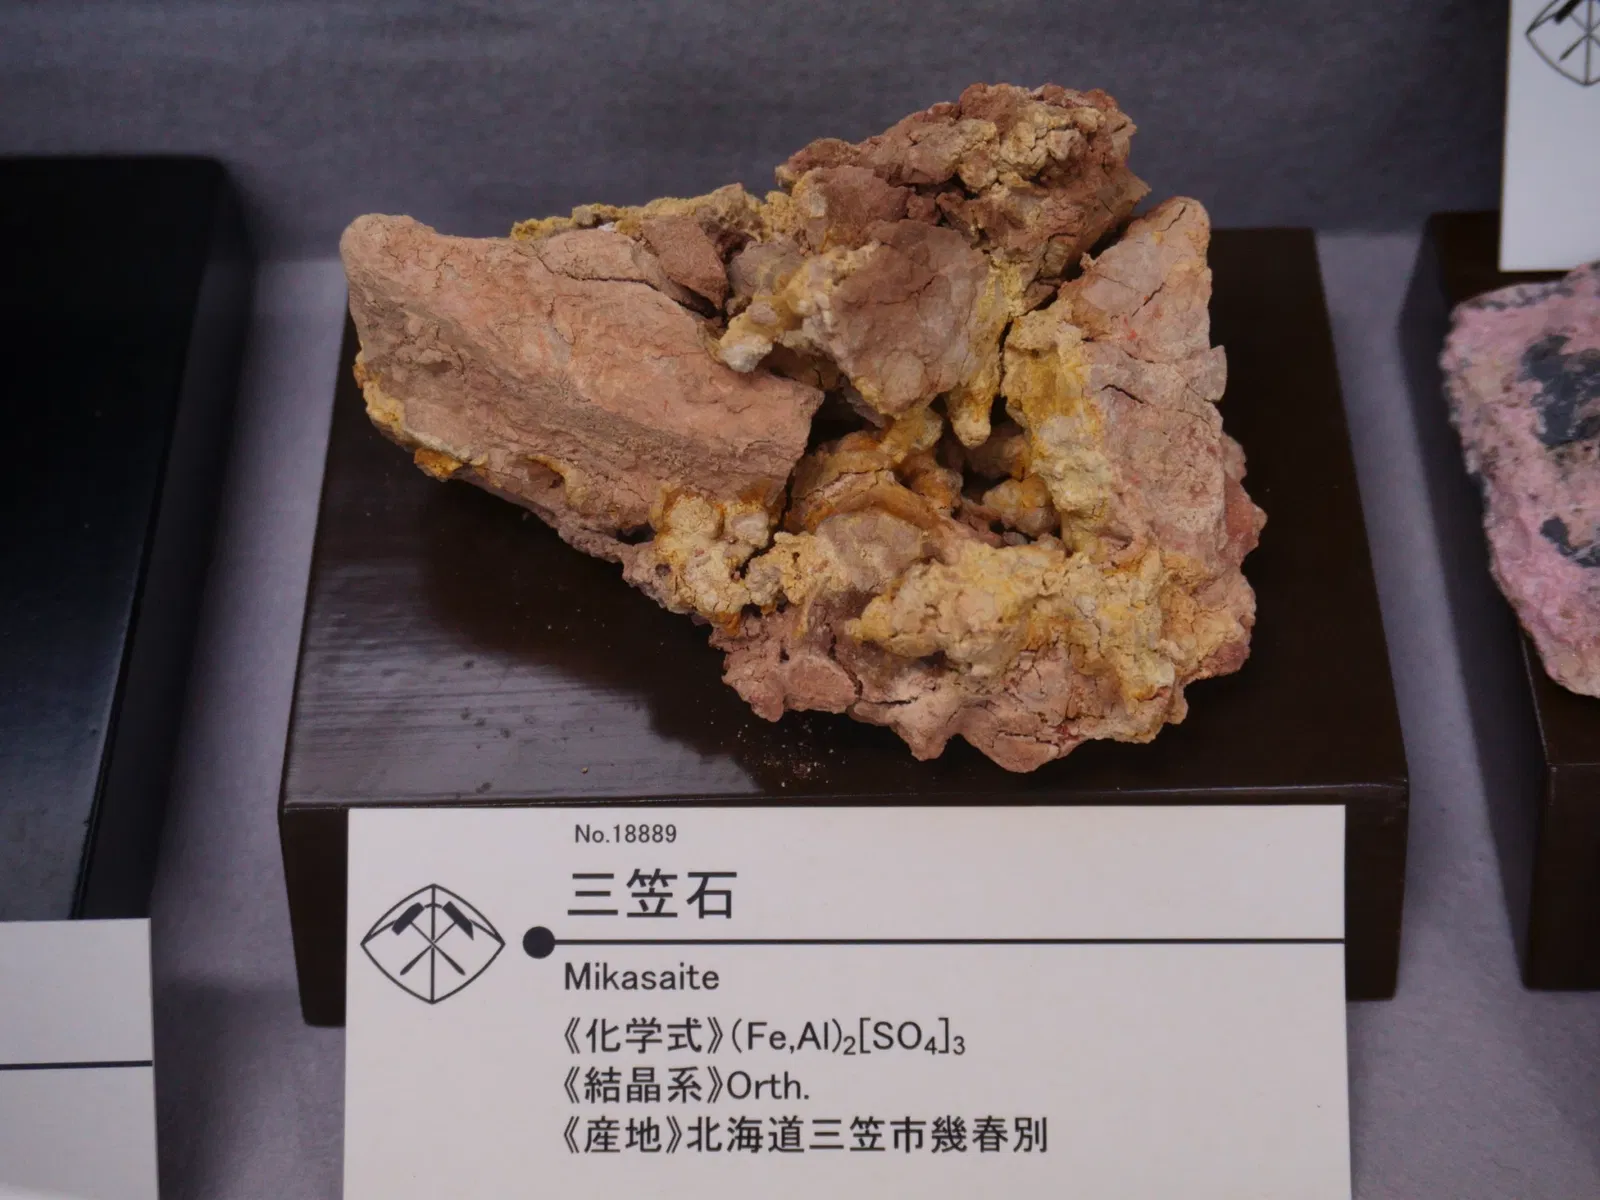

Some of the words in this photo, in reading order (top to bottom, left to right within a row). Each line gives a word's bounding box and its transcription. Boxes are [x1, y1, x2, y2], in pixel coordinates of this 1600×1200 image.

[575, 824, 677, 844] No.18889
[567, 868, 738, 919] 三笠石
[565, 961, 720, 991] Mikasaite
